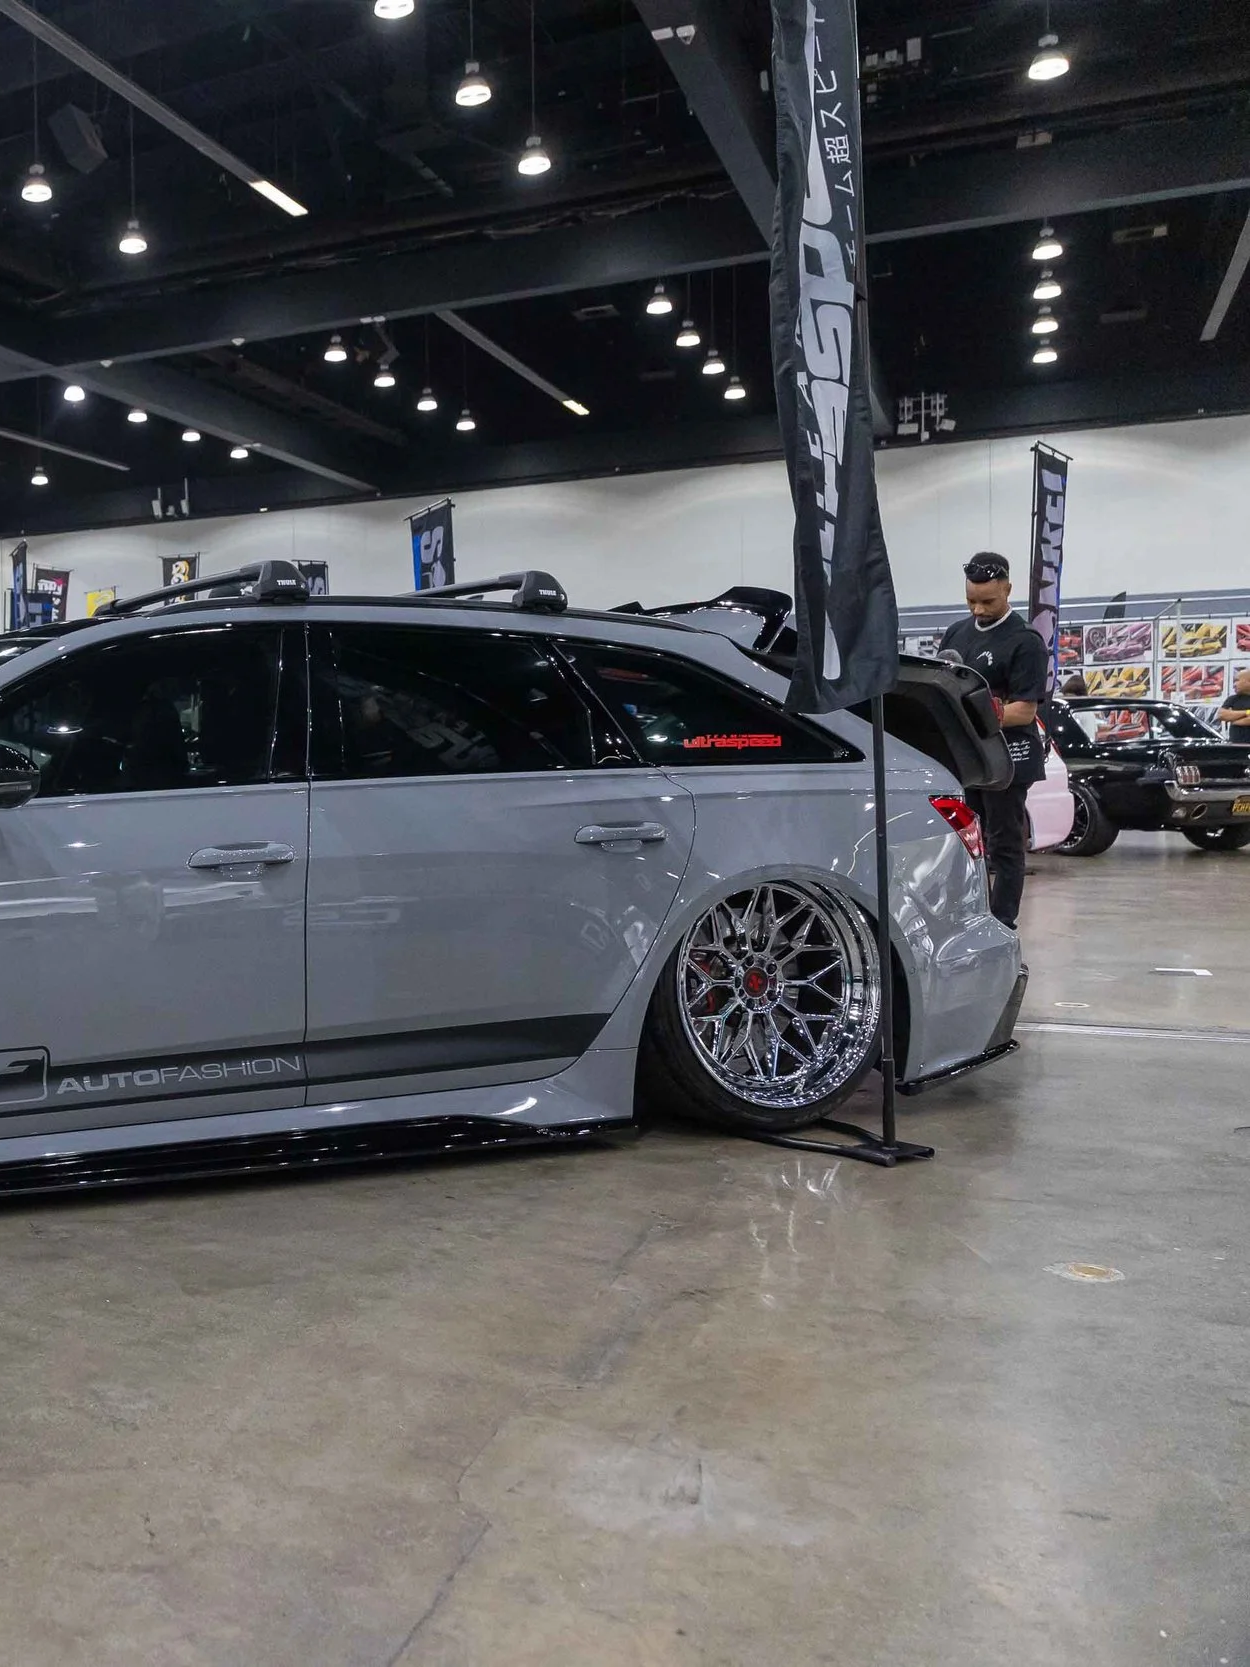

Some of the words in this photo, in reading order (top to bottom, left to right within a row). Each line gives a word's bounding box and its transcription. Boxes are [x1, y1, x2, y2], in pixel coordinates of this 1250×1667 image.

[538, 588, 557, 597] THULE
[683, 734, 782, 750] ultraspeed
[56, 1055, 301, 1096] AUTOFASHION
